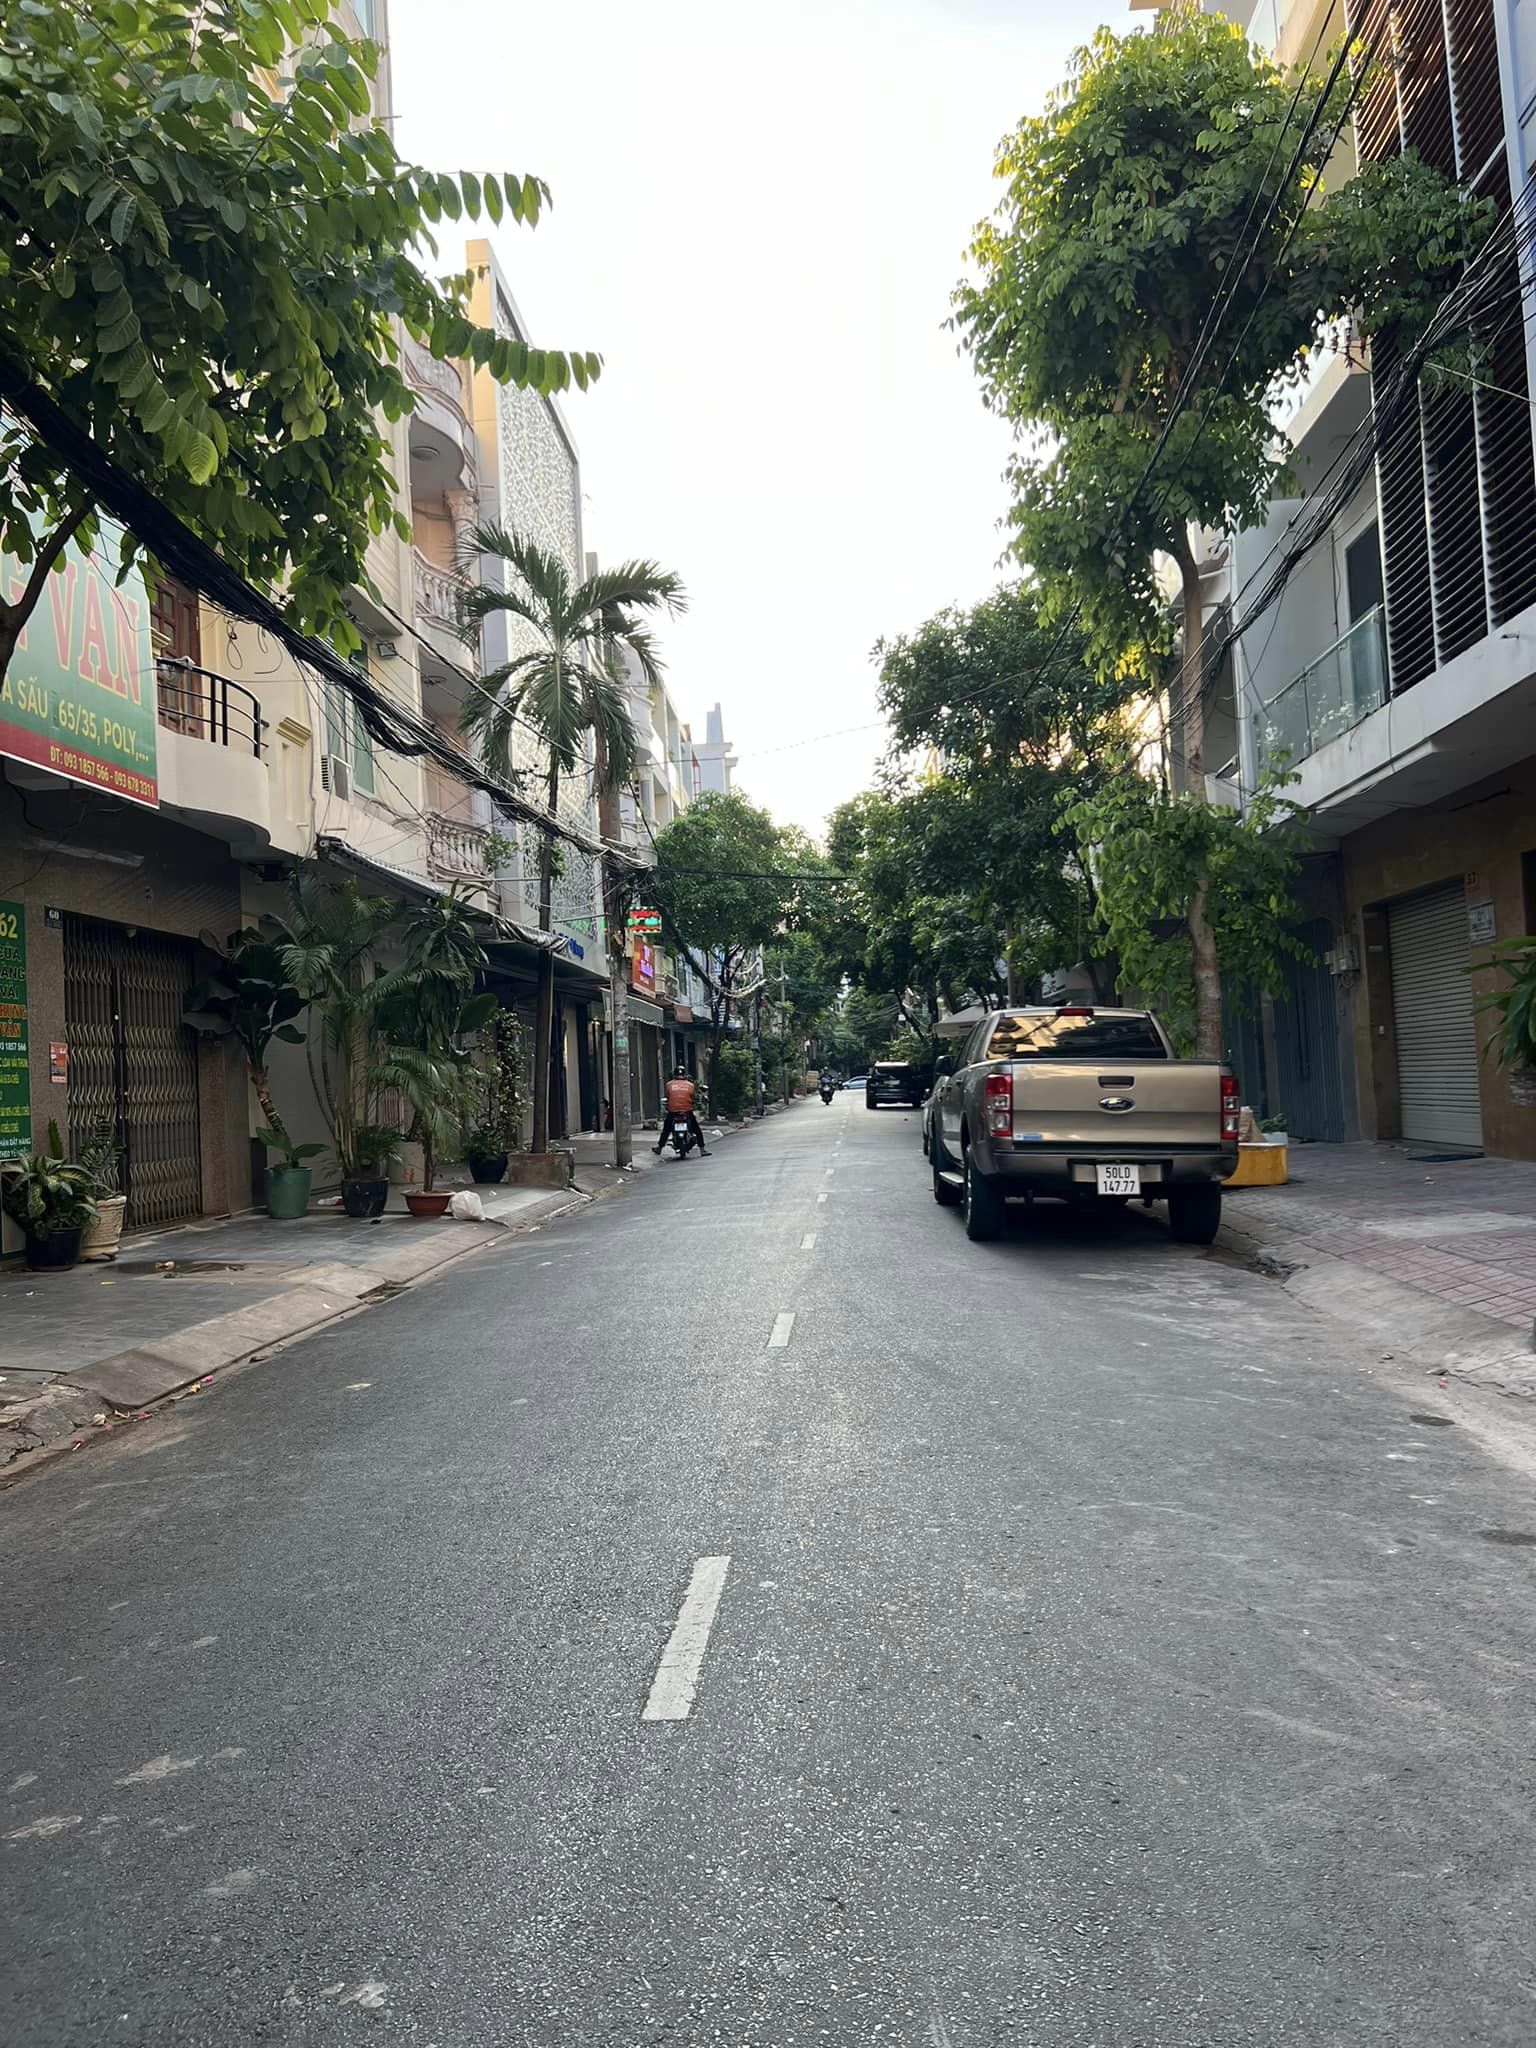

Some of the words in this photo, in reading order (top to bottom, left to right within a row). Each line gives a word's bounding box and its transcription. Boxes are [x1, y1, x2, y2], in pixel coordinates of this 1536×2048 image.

[58, 700, 100, 746] 65/35,
[63, 751, 77, 771] 093
[78, 757, 95, 777] 1857
[96, 764, 109, 782] 566
[48, 909, 60, 921] 60
[0, 912, 18, 939] 62
[1106, 1167, 1131, 1179] 50LD
[1104, 1181, 1136, 1193] 147.77
